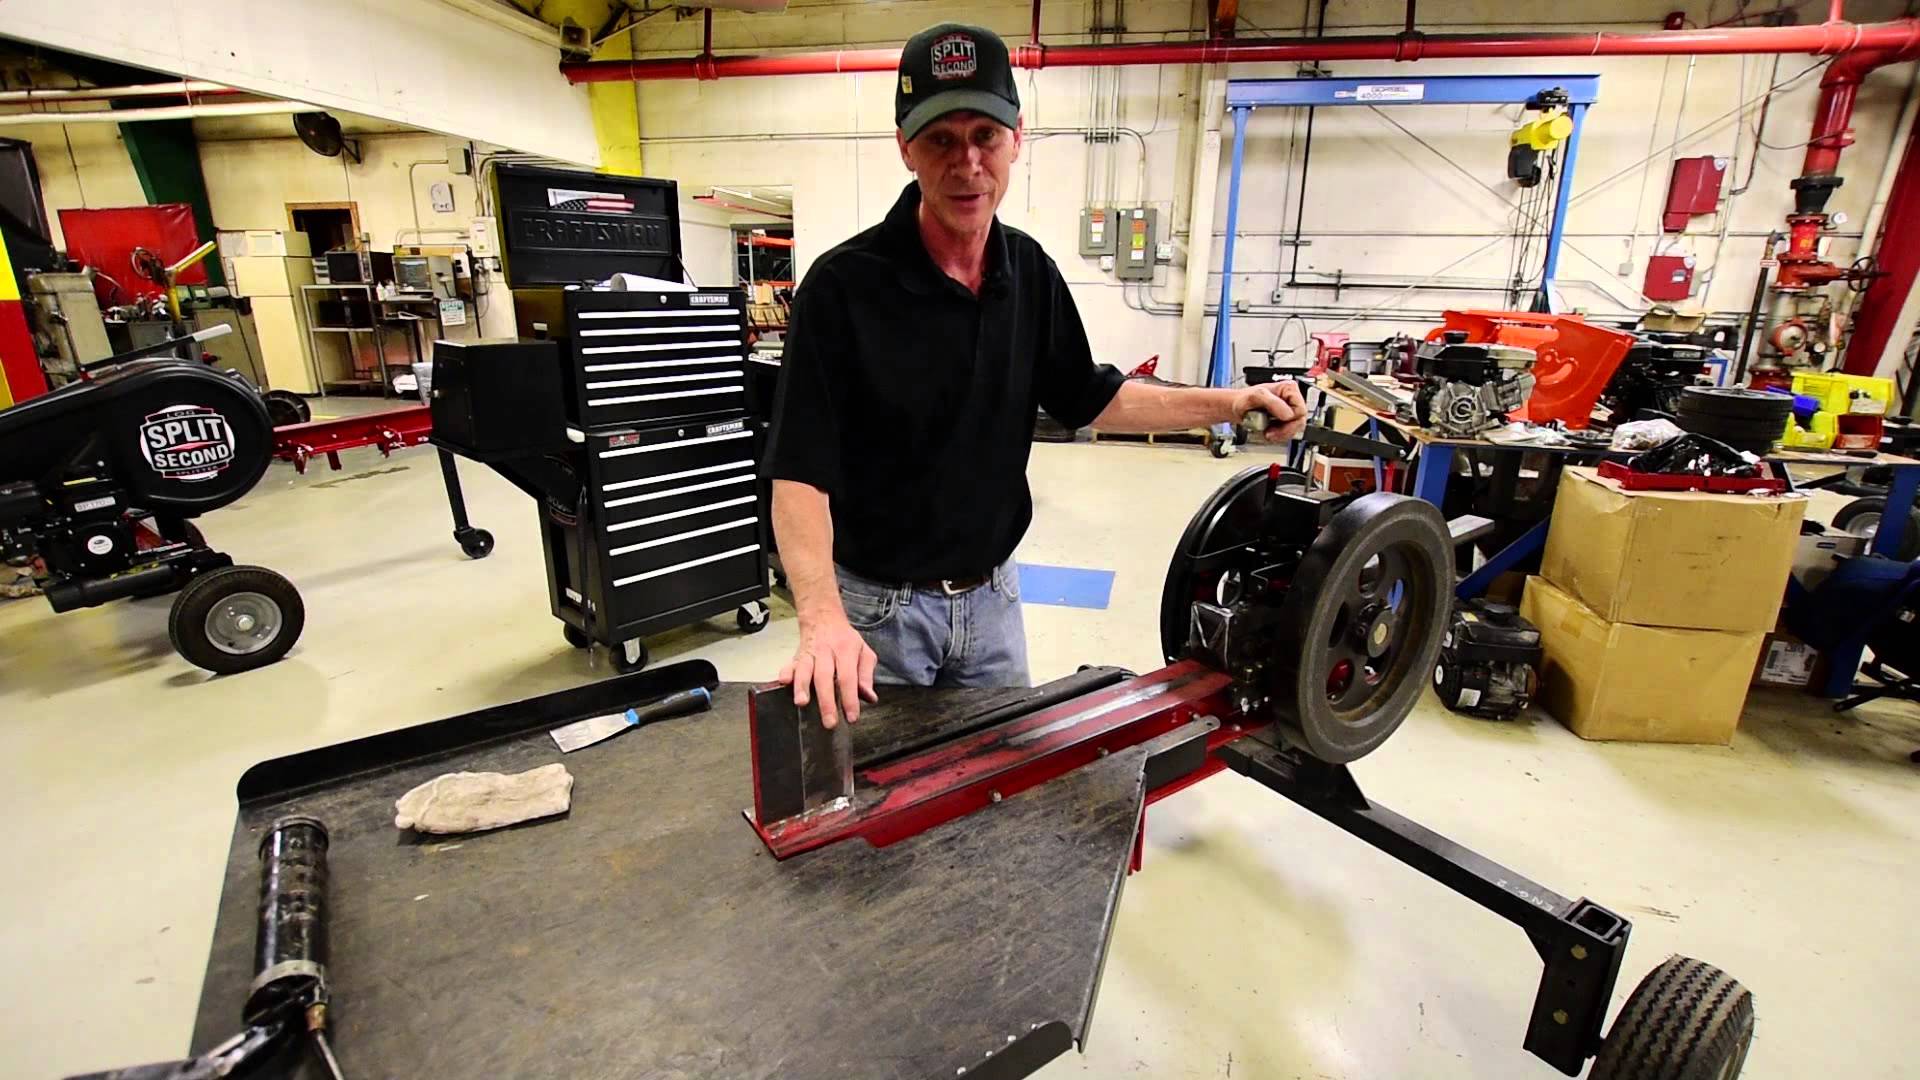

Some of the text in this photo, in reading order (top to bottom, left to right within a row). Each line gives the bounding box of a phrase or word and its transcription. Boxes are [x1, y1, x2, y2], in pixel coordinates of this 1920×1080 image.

[934, 43, 972, 62] SPLIT
[934, 60, 974, 73] SECOND
[522, 218, 660, 247] CRAFTSMAN
[147, 418, 222, 449] SPLIT
[154, 443, 230, 468] SECOND
